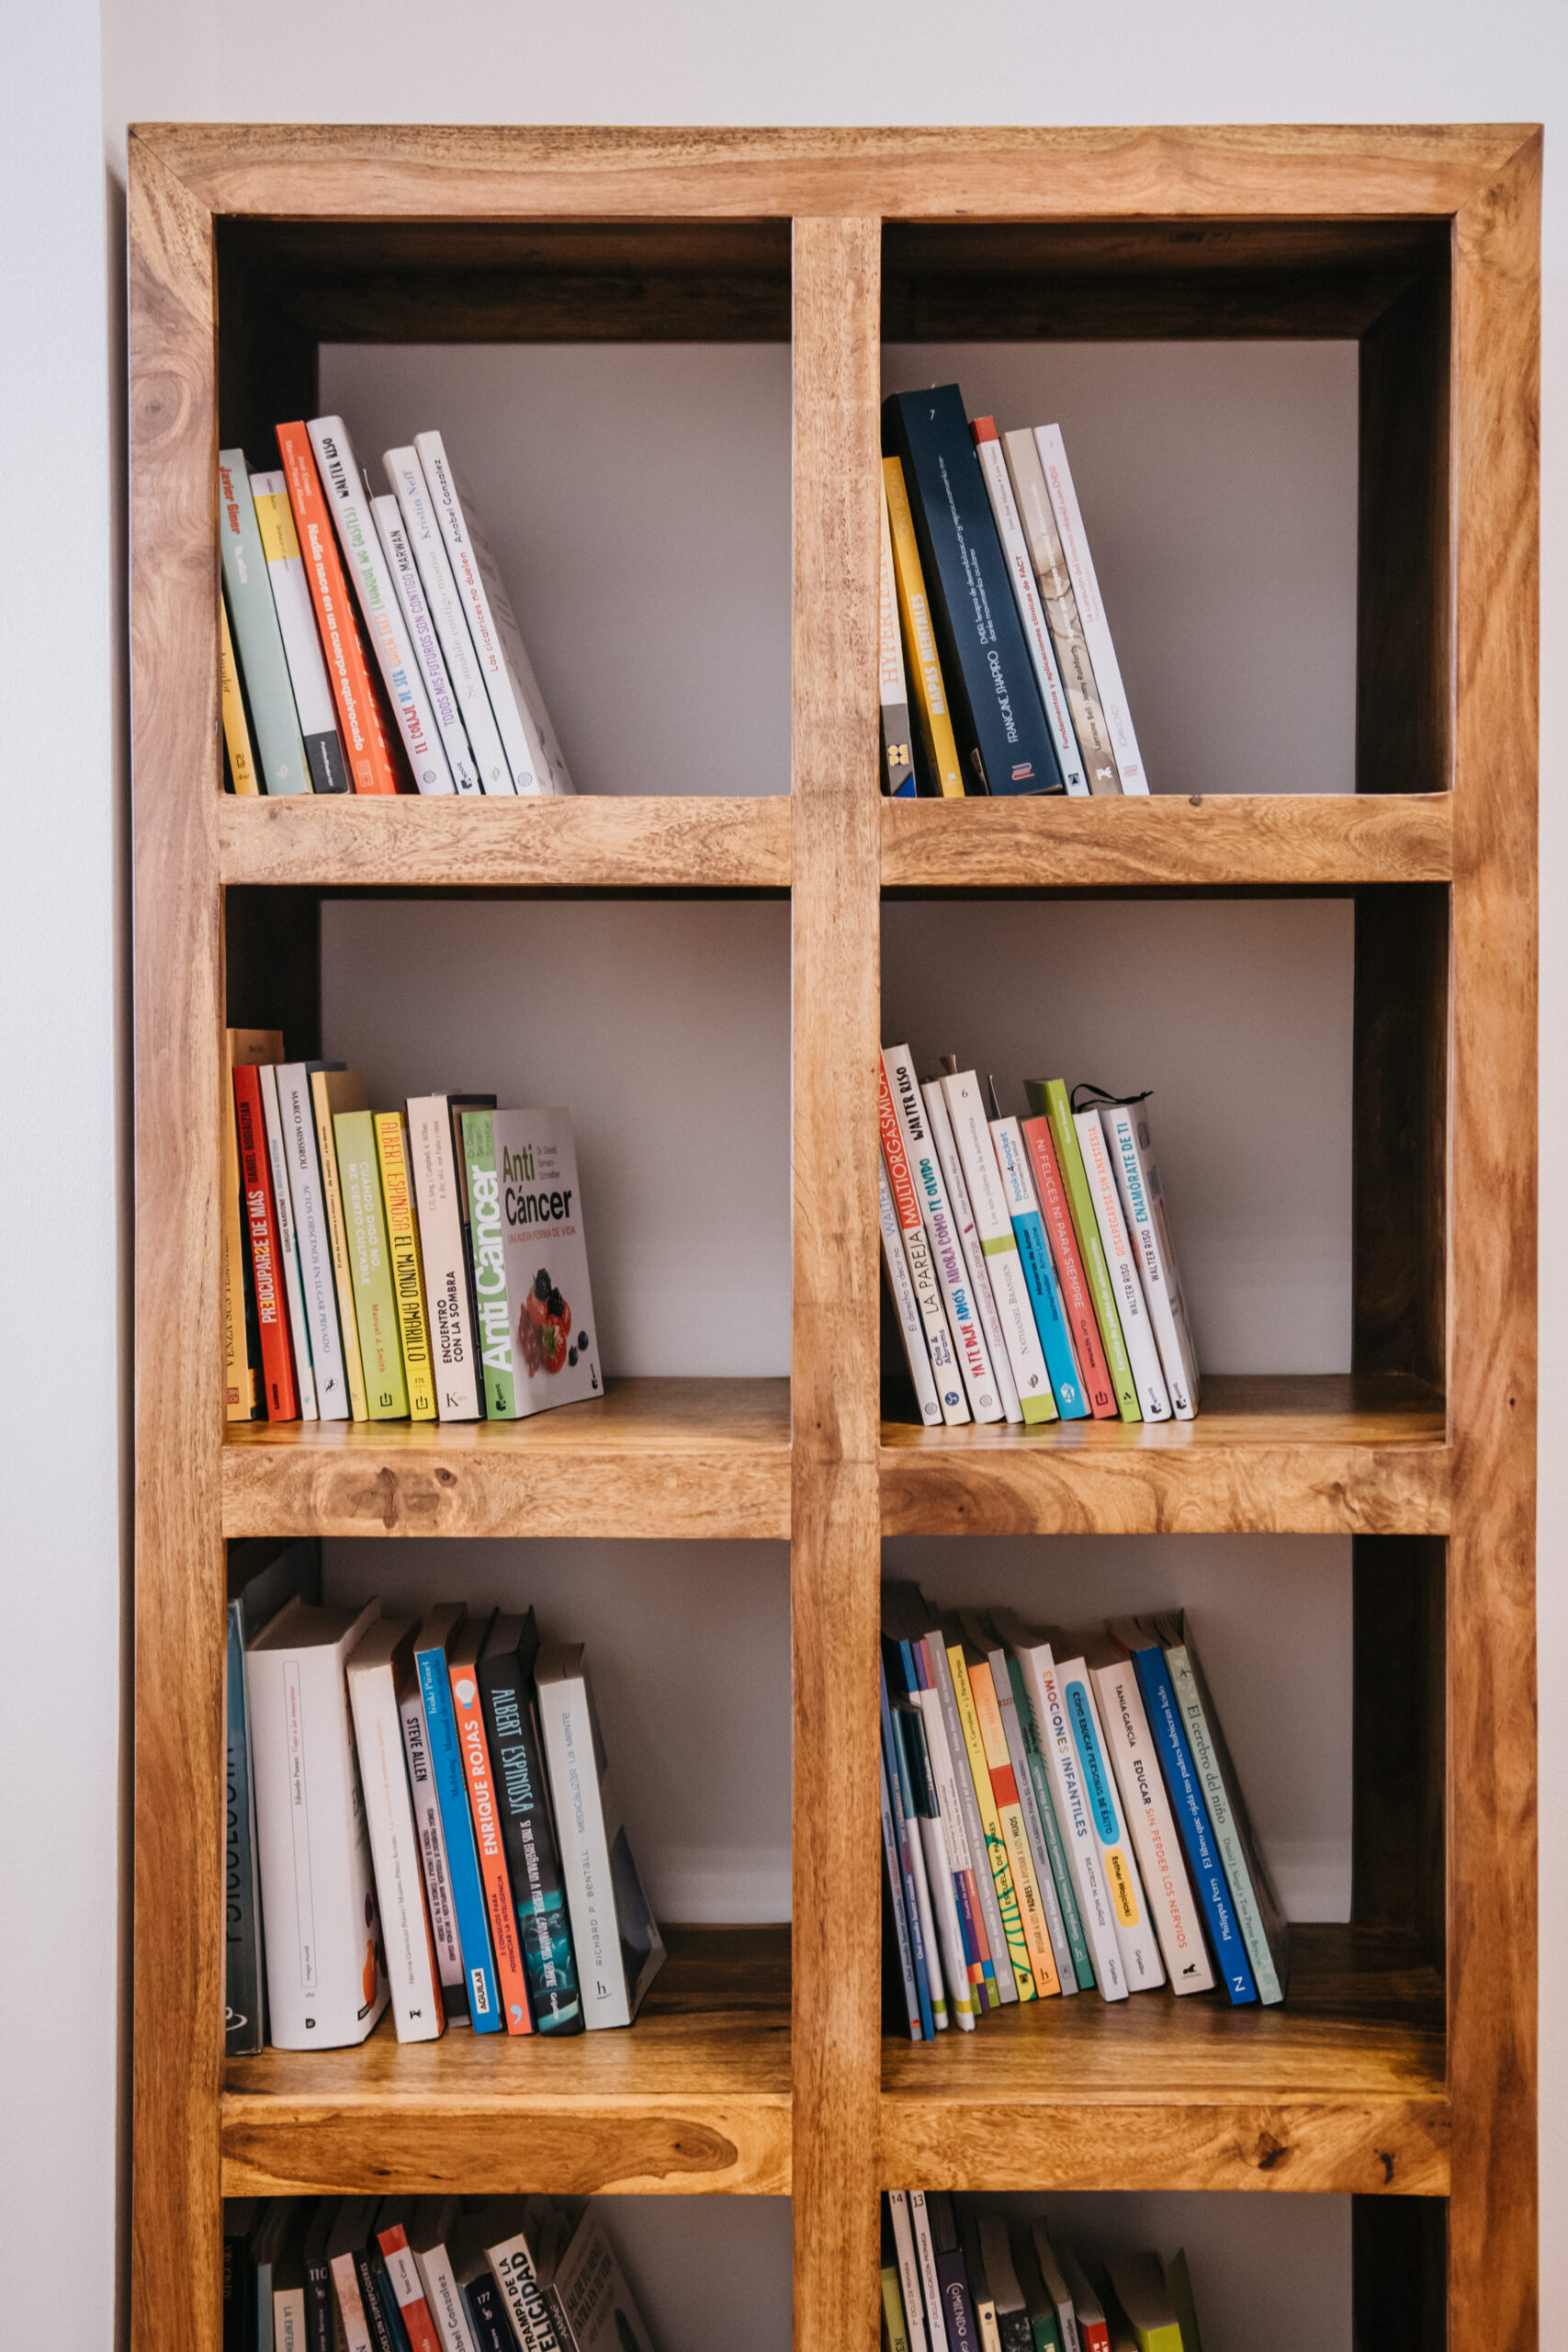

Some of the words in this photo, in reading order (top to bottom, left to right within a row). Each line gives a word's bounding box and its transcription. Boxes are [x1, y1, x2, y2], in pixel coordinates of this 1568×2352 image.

[930, 409, 935, 421] 7
[321, 435, 337, 458] RISO
[219, 466, 234, 503] Javier
[329, 460, 349, 499] WALTER
[402, 469, 416, 493] Neff
[226, 503, 240, 536] Giner
[413, 498, 430, 539] Kristin
[446, 506, 461, 544] Anabel
[307, 524, 322, 561] Nadie
[390, 528, 408, 571] MARWAN
[315, 562, 329, 594] nace
[459, 550, 474, 585] duelen
[1015, 555, 1026, 578] FACT
[401, 571, 423, 613] CONTIGO
[469, 587, 478, 601] no
[1022, 581, 1029, 592] de
[322, 596, 333, 612] en
[1026, 594, 1038, 626] clínicas
[327, 614, 336, 629] un
[414, 614, 429, 633] SON
[474, 604, 492, 651] cicatrices
[910, 594, 935, 662] MENTALES
[330, 631, 346, 675] cuerpo
[419, 633, 440, 676] FUTUROS
[488, 654, 498, 672] Las
[1035, 626, 1053, 681] aplicaciones
[432, 675, 446, 695] MIS
[987, 649, 1007, 695] SHAPIRO
[399, 689, 412, 702] DE
[925, 668, 945, 716] MAPAS
[340, 677, 363, 752] equivocado
[402, 704, 423, 739] CORAJE
[437, 694, 454, 725] TODOS
[998, 694, 1018, 742] FRANCINE
[1051, 693, 1069, 749] Fundamentos
[1084, 707, 1093, 720] Bell
[414, 741, 428, 753] EL
[1088, 722, 1100, 751] Lorraine
[896, 1067, 911, 1094] RISO
[291, 1091, 301, 1124] MARCO
[296, 1125, 307, 1170] MISSIROLI
[902, 1094, 923, 1142] WALTER
[1116, 1122, 1128, 1134] TI
[381, 1122, 402, 1167] ALBERT
[1035, 1138, 1045, 1153] NI
[1088, 1126, 1105, 1174] ANESTESIA
[1119, 1135, 1132, 1151] DE
[244, 1152, 257, 1183] DANIEL
[348, 1162, 358, 1181] ME
[503, 1144, 535, 1183] Anti
[919, 1159, 937, 1197] OLVIDO
[999, 1130, 1021, 1202] books4pocket
[1040, 1154, 1058, 1204] FELICES
[302, 1185, 312, 1213] ACTOS
[359, 1161, 373, 1212] CUANDO
[1100, 1176, 1110, 1192] SIN
[1122, 1153, 1147, 1223] ENAMÓRATE
[247, 1190, 265, 1217] MÁS
[350, 1183, 364, 1226] SIENTO
[387, 1172, 410, 1231] ESPINOSA
[505, 1185, 572, 1226] Cáncer
[928, 1200, 942, 1213] TE
[1052, 1206, 1062, 1220] NI
[251, 1220, 266, 1235] DE
[307, 1216, 319, 1262] OBSCENOS
[365, 1215, 378, 1245] DIGO
[471, 1163, 505, 1295] Cáncer
[932, 1213, 951, 1246] CÓMO
[1022, 1229, 1032, 1250] Amar
[1055, 1222, 1070, 1255] PARA
[1103, 1193, 1124, 1256] DESAPEGARSE
[1141, 1228, 1152, 1249] RISO
[355, 1228, 370, 1284] CULPABLE
[394, 1236, 412, 1247] EL
[1028, 1250, 1034, 1261] de
[312, 1266, 321, 1278] EN
[369, 1248, 380, 1271] NO,
[908, 1230, 931, 1288] PAREJA
[940, 1247, 959, 1284] AHORA
[1120, 1263, 1131, 1283] RISO
[1145, 1250, 1158, 1281] WALTER
[397, 1254, 418, 1299] MUNDO
[1031, 1261, 1043, 1295] Maneras
[1064, 1256, 1083, 1308] SIEMPRE
[314, 1281, 325, 1311] LUGAR
[446, 1271, 458, 1317] SOMBRA
[922, 1293, 939, 1314] LA
[951, 1288, 969, 1321] ADIÓS
[1124, 1283, 1138, 1315] WALTER
[319, 1313, 330, 1353] PRIVADO
[371, 1304, 381, 1335] Manuel
[376, 1347, 385, 1373] Smith
[402, 1303, 425, 1361] AMARILLO
[437, 1298, 452, 1363] ENCUENTRO
[450, 1321, 460, 1333] LA
[960, 1323, 977, 1348] DIJE
[453, 1338, 463, 1362] CON
[933, 1346, 943, 1365] Chia
[939, 1328, 951, 1363] Abrams
[966, 1348, 981, 1363] TE
[971, 1363, 985, 1378] YA
[492, 1687, 521, 1737] ALBERT
[1072, 1690, 1084, 1718] CÓMO
[1115, 1685, 1126, 1713] TANIA
[1122, 1712, 1135, 1747] GARCÍA
[1186, 1704, 1201, 1719] El
[406, 1717, 423, 1748] STEVE
[464, 1720, 485, 1776] ROJAS
[1078, 1719, 1092, 1752] EDUCAR
[1191, 1720, 1210, 1770] cerebro
[412, 1749, 427, 1781] ALLEN
[1043, 1670, 1066, 1753] EMOCIONES
[1061, 1757, 1087, 1837] INFANTILES
[1175, 1746, 1189, 1776] padres
[501, 1745, 533, 1815] ESPINOSA
[1087, 1753, 1102, 1794] PERSONAS
[1205, 1771, 1221, 1792] del
[474, 1781, 497, 1855] ENRIQUE
[1098, 1797, 1106, 1808] DE
[1211, 1795, 1225, 1825] niño
[988, 1821, 1000, 1851] PADRES
[1010, 1816, 1019, 1837] HIJOS
[1100, 1809, 1112, 1834] ÉXITO
[1193, 1815, 1204, 1832] que
[995, 1855, 1003, 1866] DE
[1133, 1758, 1151, 1805] EDUCAR
[1145, 1807, 1156, 1826] SIN
[1151, 1829, 1168, 1873] PERDER
[1162, 1875, 1174, 1897] LOS
[1168, 1900, 1187, 1949] NERVIOS
[1198, 1834, 1209, 1856] libro
[1084, 1858, 1096, 1887] BEATRIZ
[1201, 1856, 1212, 1868] El
[997, 1868, 1010, 1905] ESCUELA
[1023, 1885, 1035, 1912] PADRES
[1111, 1855, 1122, 1880] Esther
[1118, 1881, 1131, 1917] Wojcicki
[1210, 1877, 1221, 1901] Perry
[1223, 1837, 1235, 1860] Daniel
[1239, 1898, 1247, 1915] Tina
[1244, 1917, 1254, 1939] Payne
[494, 1913, 505, 1949] CONSEJOS
[503, 1923, 511, 1932] LA
[1216, 1902, 1231, 1940] Philippa
[474, 1971, 486, 2009] AGUILAR
[891, 2193, 903, 2204] 14
[913, 2194, 924, 2208] 13
[310, 2268, 328, 2281] 110
[498, 2256, 511, 2275] LA
[438, 2273, 457, 2328] Gonzalez
[504, 2277, 518, 2296] DE
[283, 2305, 292, 2316] LA
[513, 2299, 537, 2351] TRAMPA
[931, 2301, 939, 2320] CICLO
[947, 2282, 967, 2336] COMIENDO
